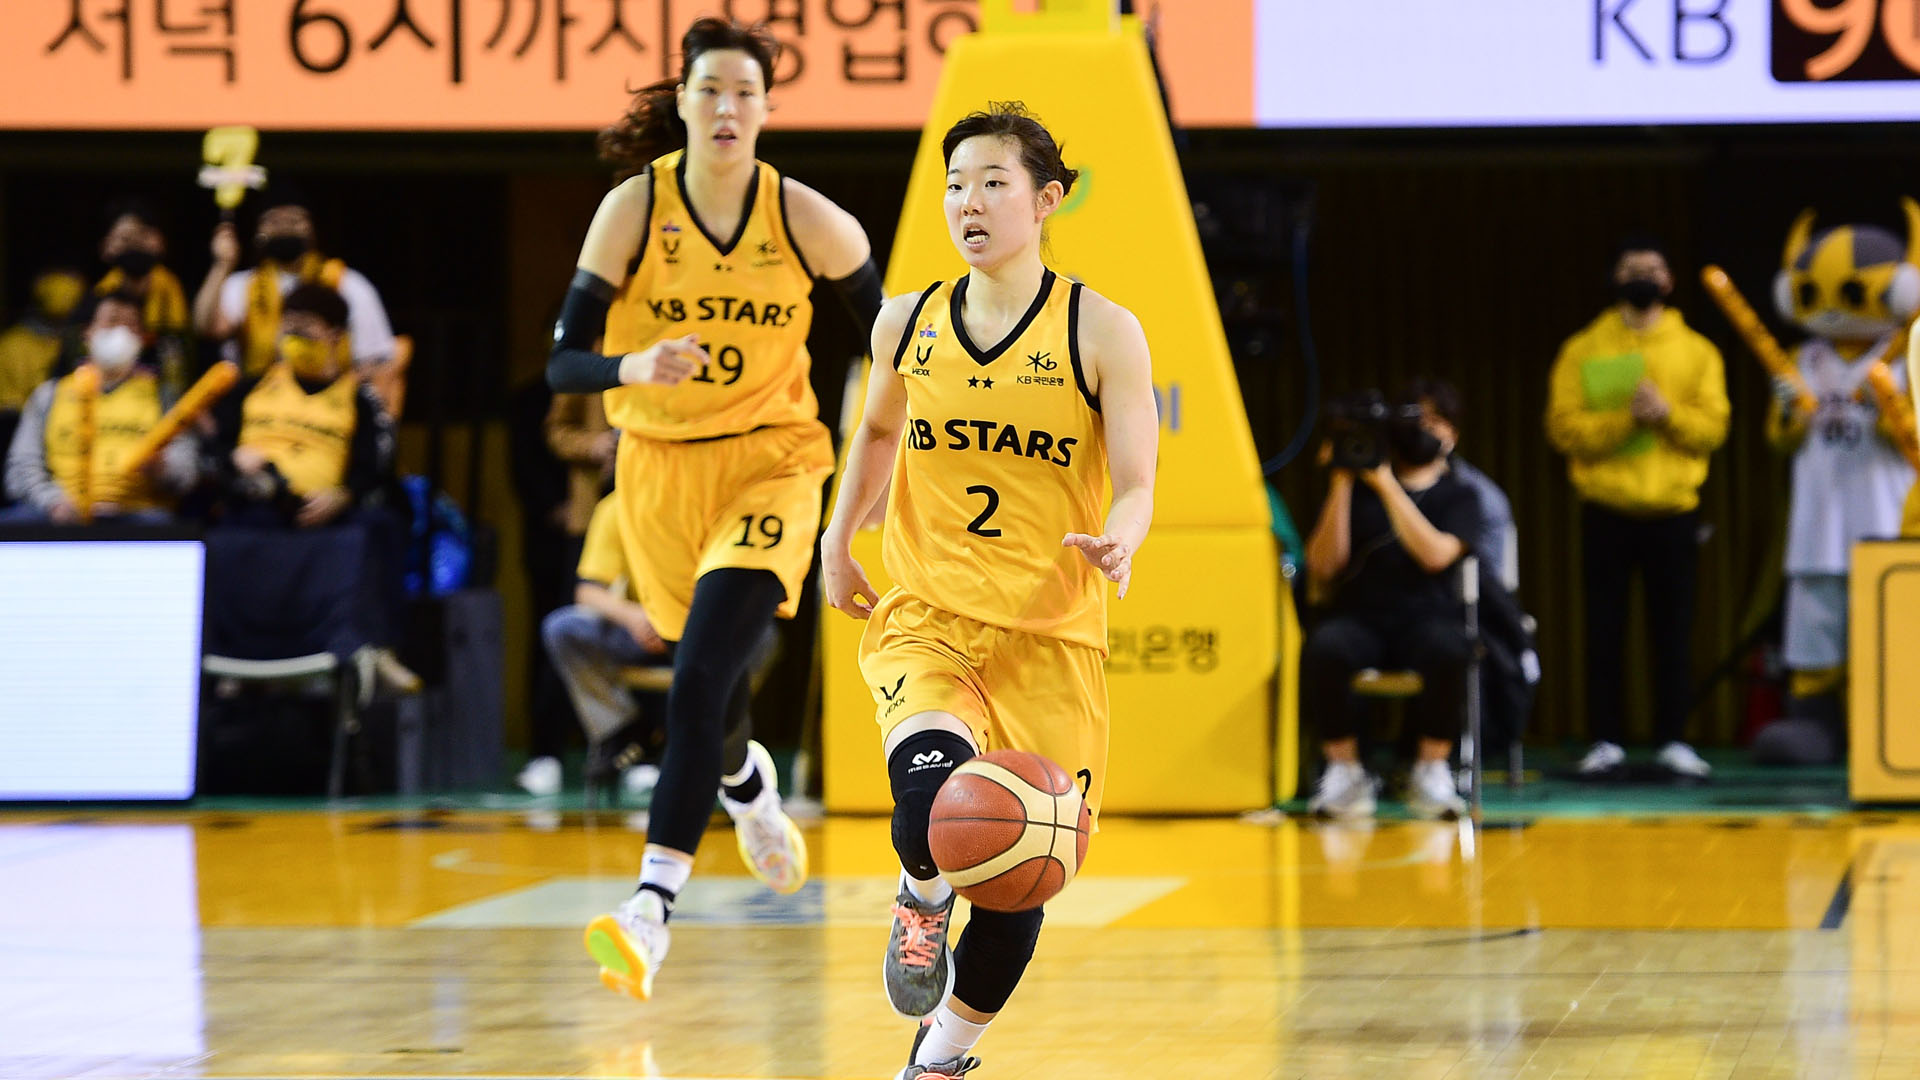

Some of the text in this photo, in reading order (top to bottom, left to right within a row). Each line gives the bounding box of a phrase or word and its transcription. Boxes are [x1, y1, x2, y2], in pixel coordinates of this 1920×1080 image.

[1593, 0, 1733, 62] KB
[647, 297, 797, 327] KB STARS
[691, 343, 744, 386] 19
[944, 418, 1079, 468] STARS
[733, 514, 783, 550] 19
[965, 485, 1002, 538] 2
